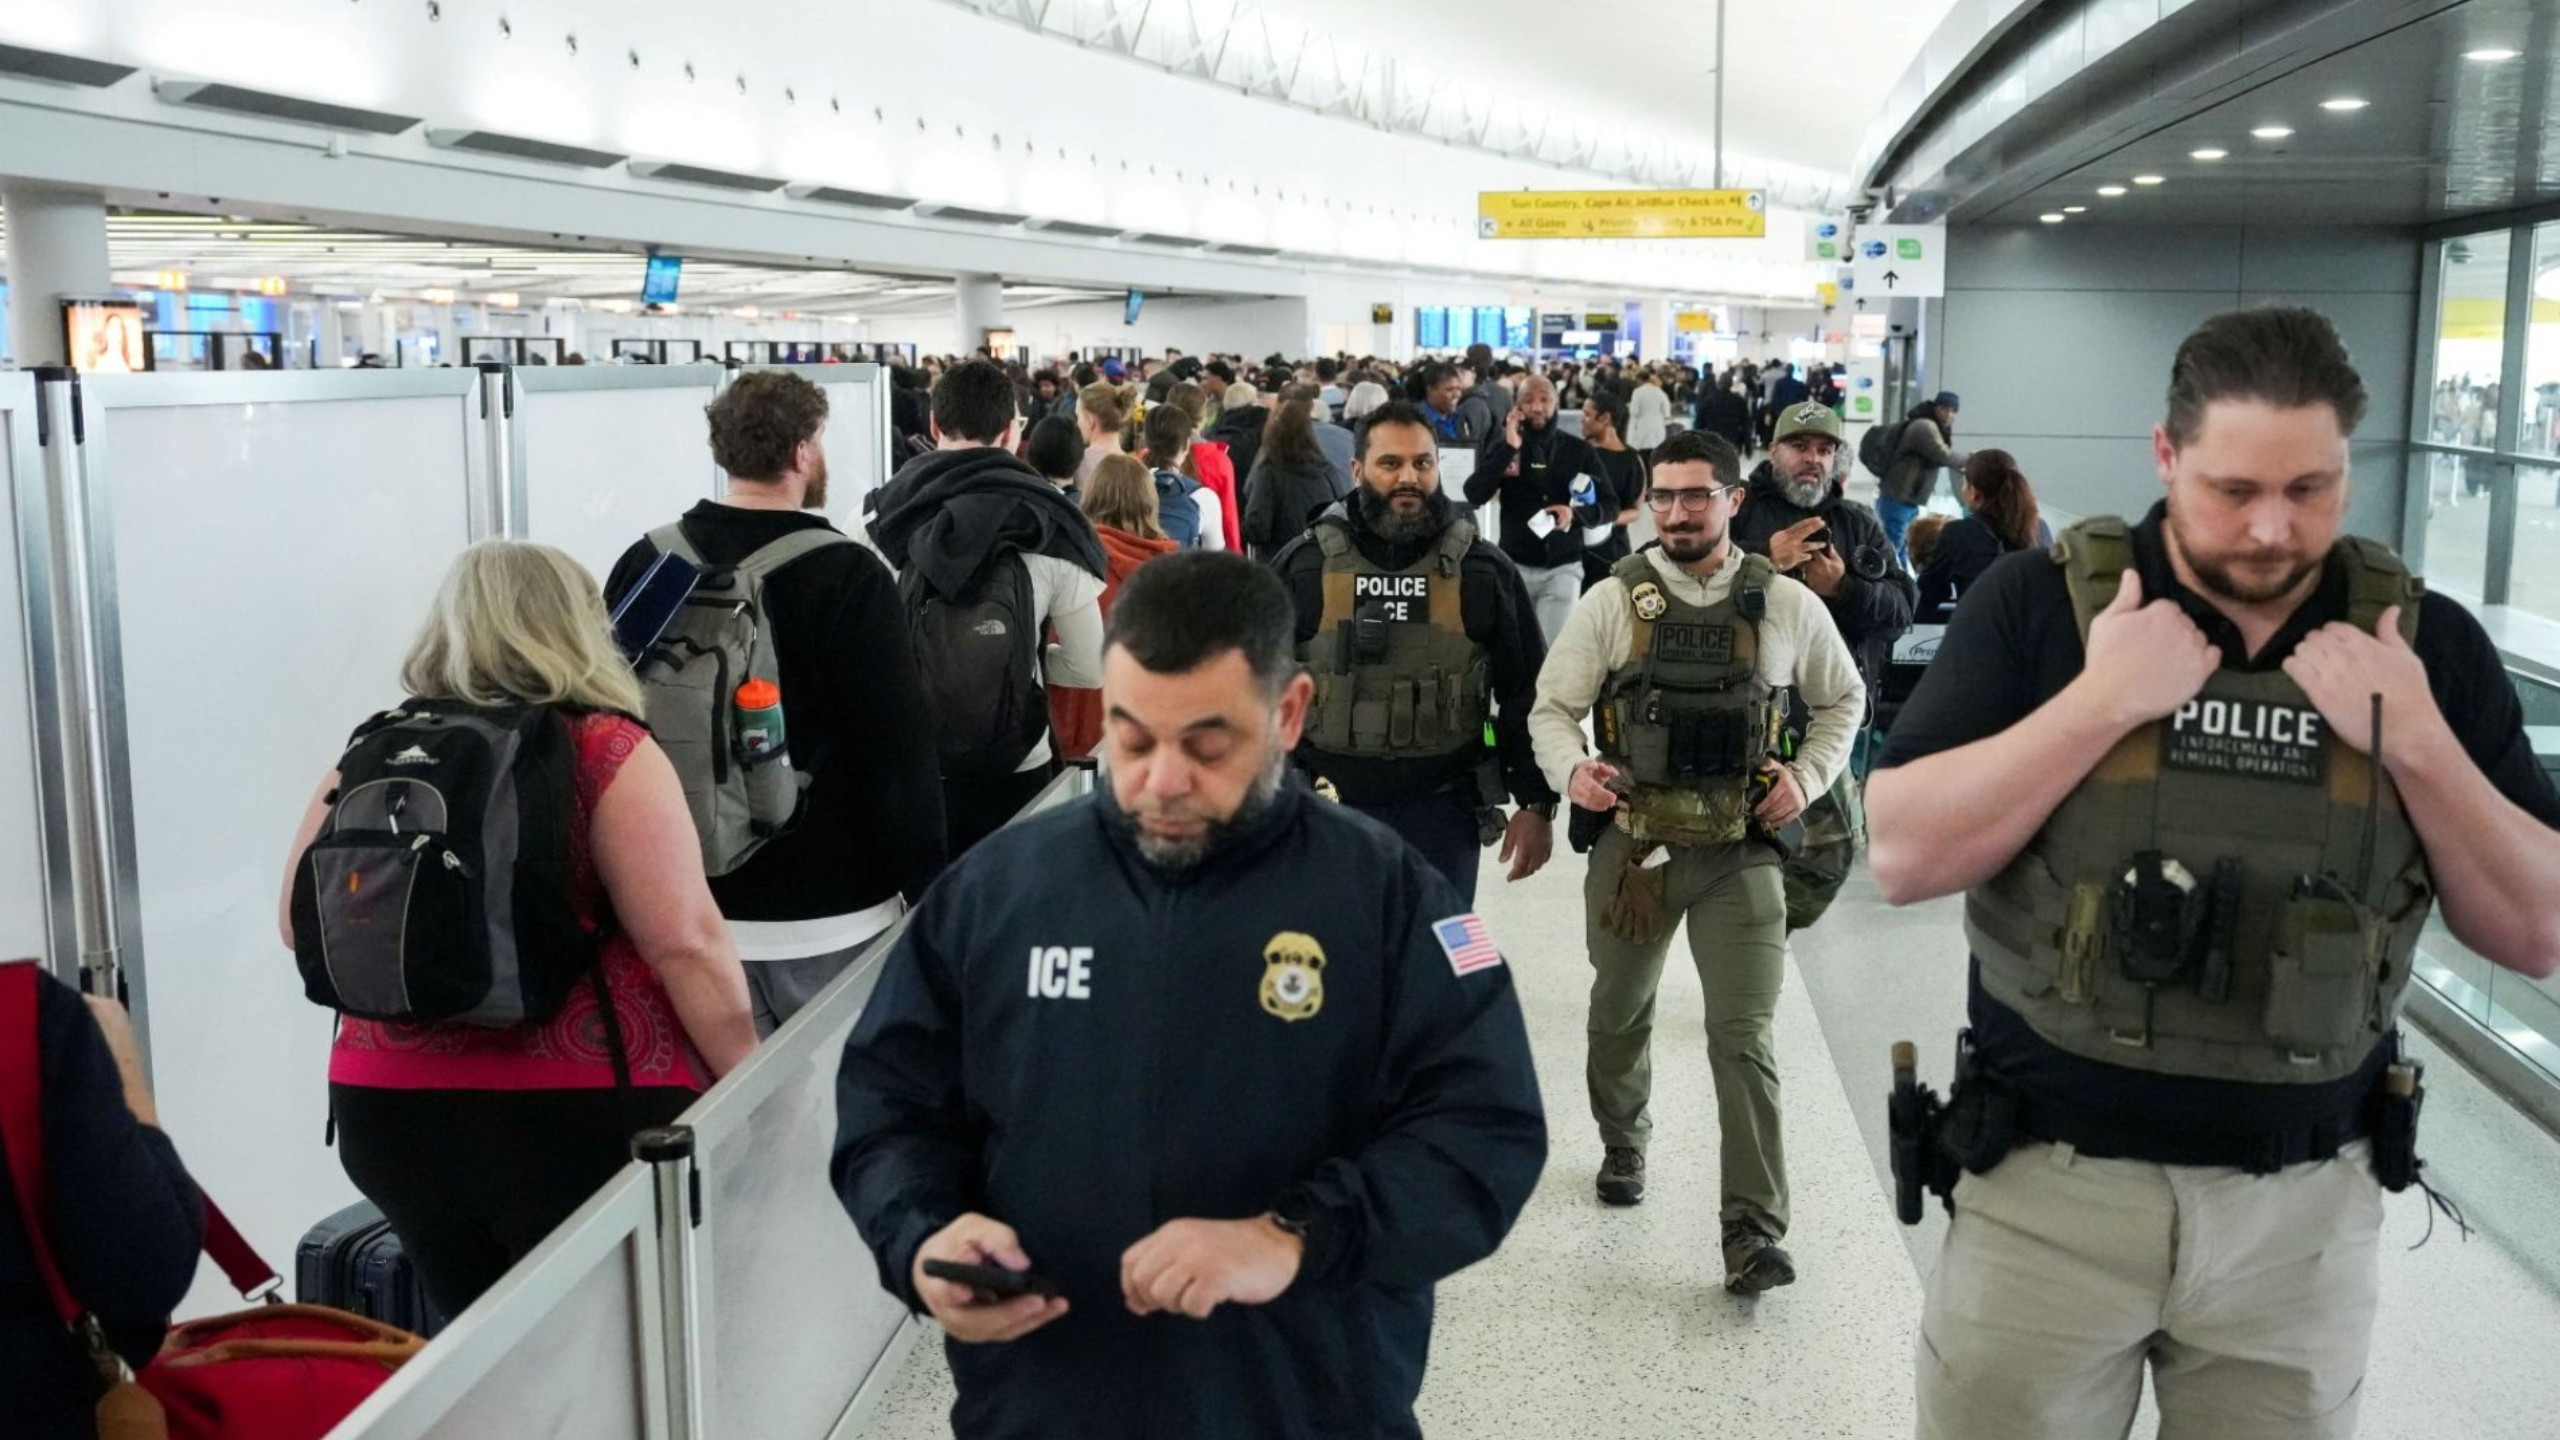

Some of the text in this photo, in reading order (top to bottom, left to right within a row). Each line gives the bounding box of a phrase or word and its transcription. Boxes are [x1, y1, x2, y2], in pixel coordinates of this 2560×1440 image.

[1511, 199, 1532, 208] Sun
[1585, 198, 1613, 209] Cape
[1536, 218, 1567, 228] Gates
[1701, 217, 1723, 226] TSA
[1356, 576, 1426, 596] POLICE
[1663, 626, 1730, 650] POLICE
[2173, 699, 2320, 747] POLICE
[2180, 735, 2277, 757] ENFORCEMENT
[2170, 748, 2230, 769] REMOVAL
[1027, 946, 1094, 999] ICE
